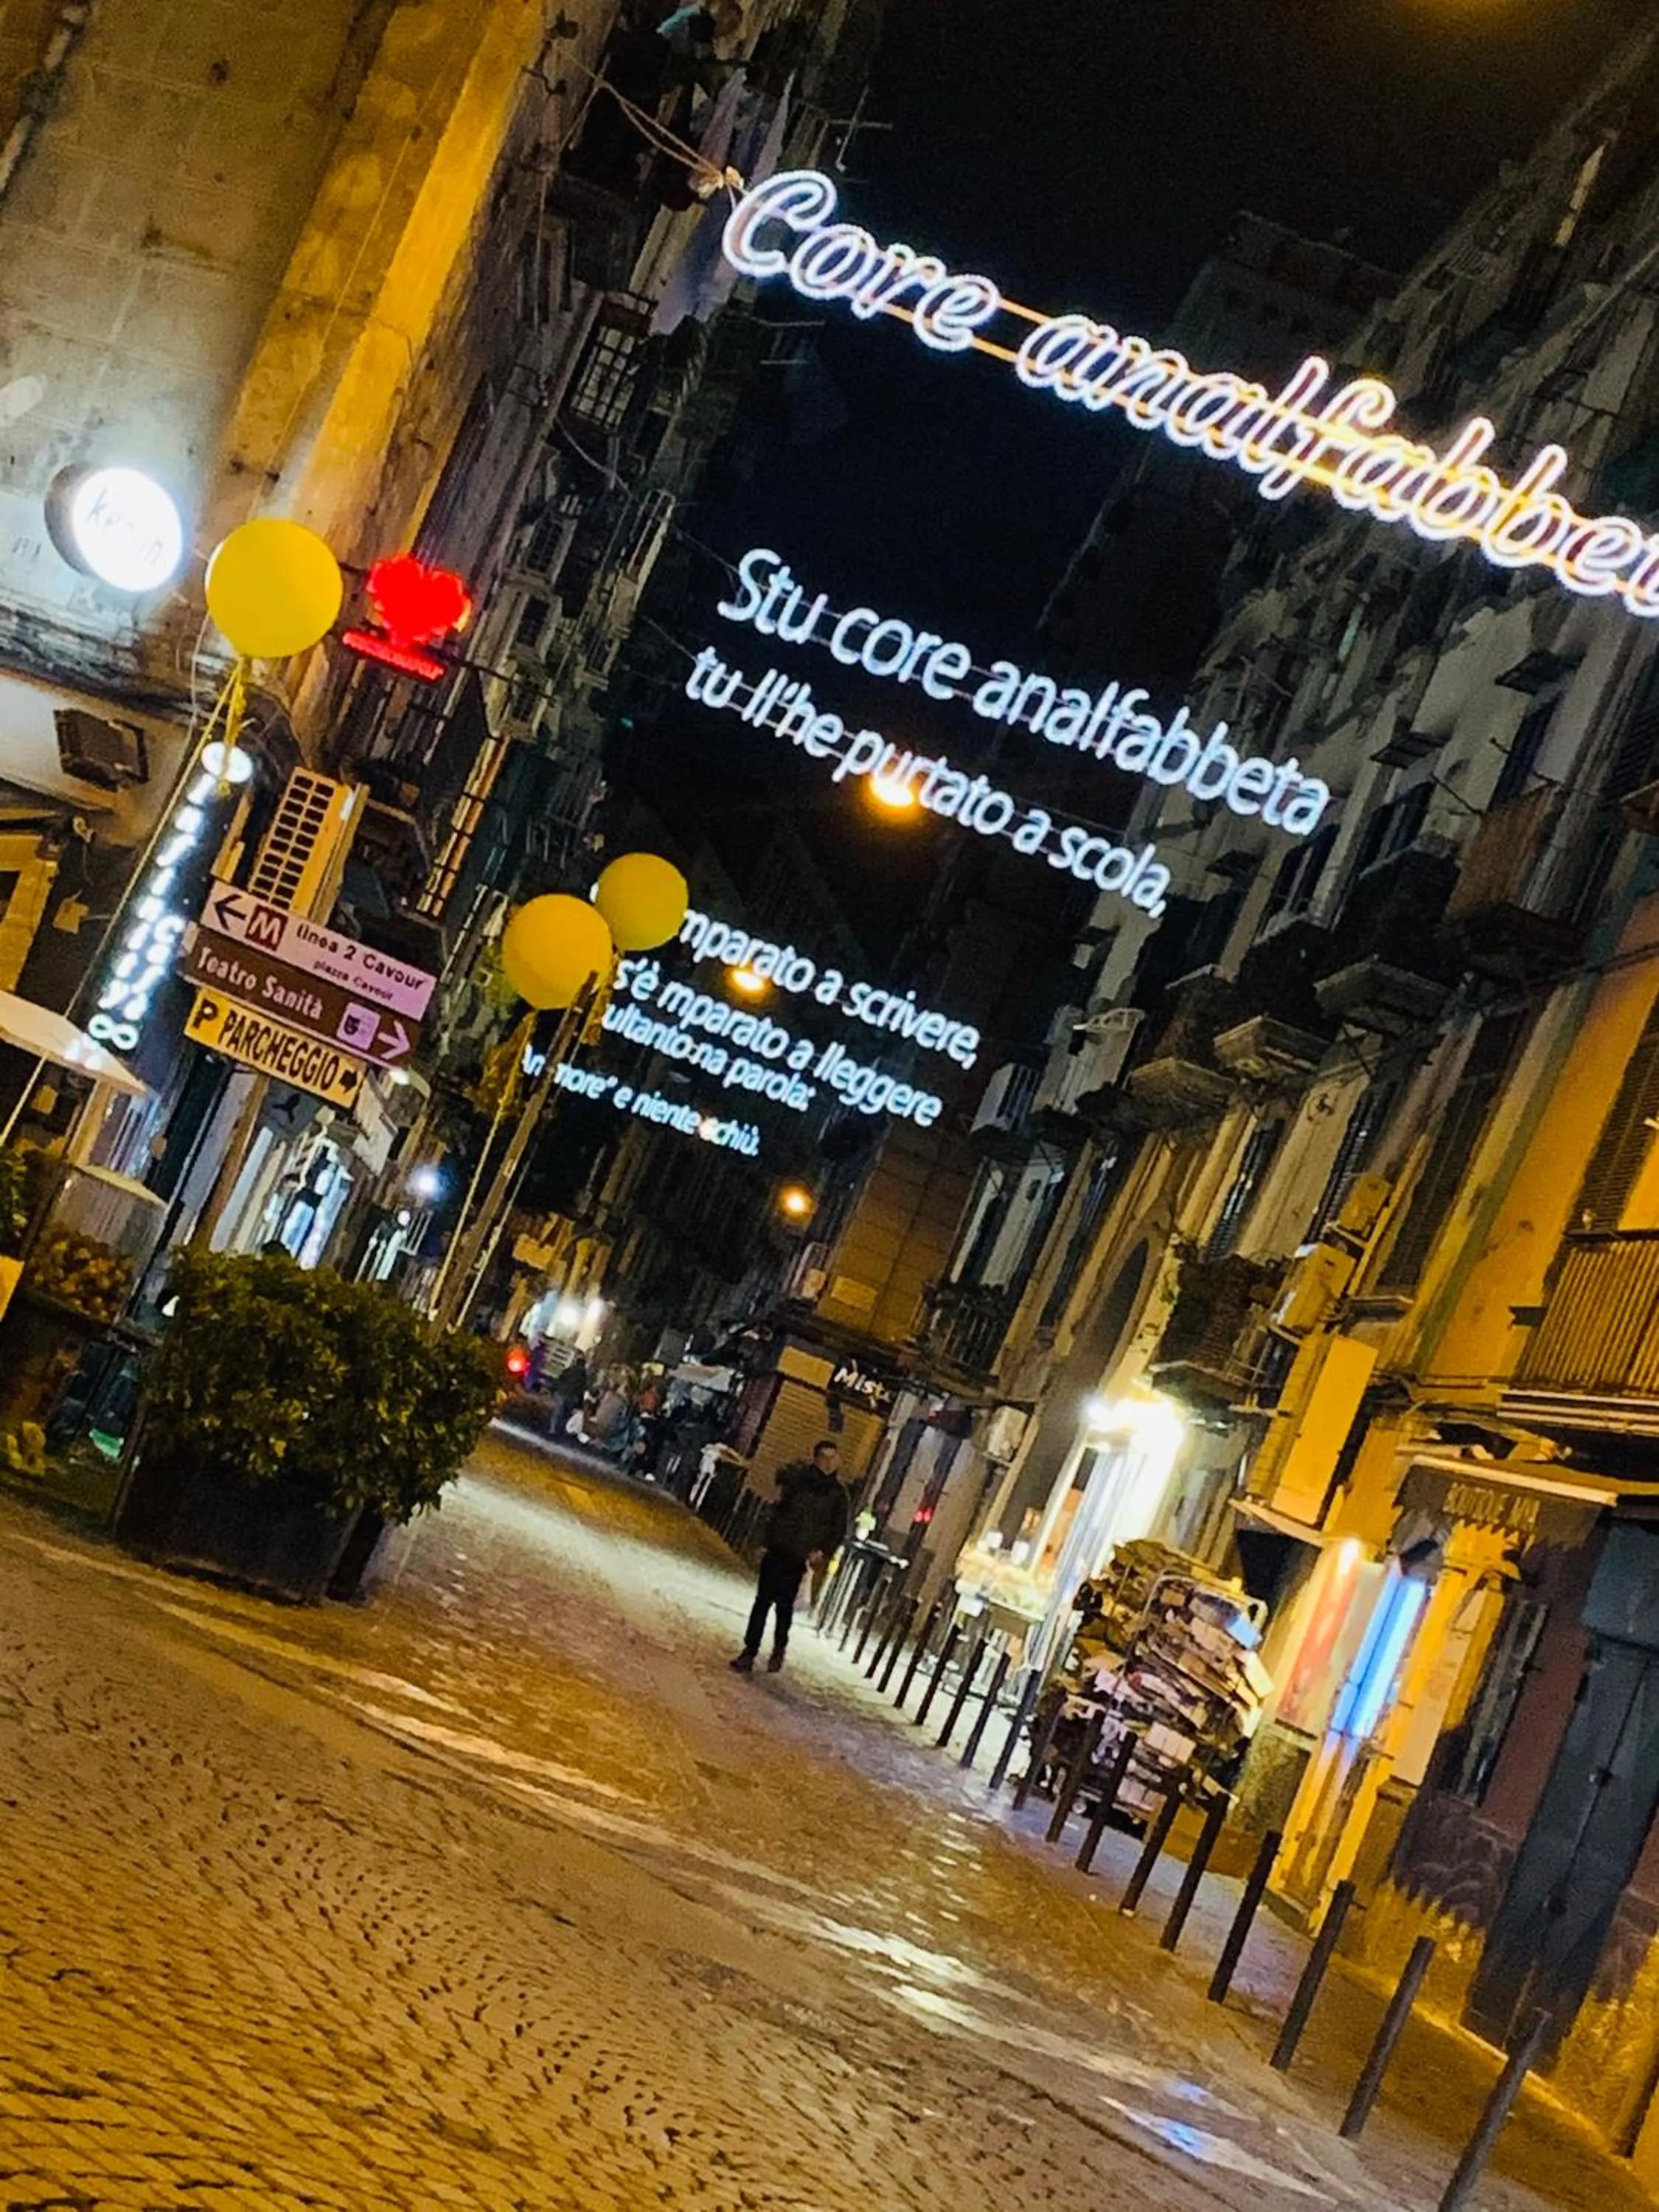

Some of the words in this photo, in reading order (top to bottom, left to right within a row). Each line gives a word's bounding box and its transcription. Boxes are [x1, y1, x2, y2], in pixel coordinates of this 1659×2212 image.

[720, 169, 1003, 352] Core
[717, 547, 829, 643] Stu
[830, 606, 970, 700] core
[973, 659, 1330, 836] analfabbeta
[684, 646, 743, 709] tu
[830, 730, 1015, 835] purtato
[1011, 807, 1051, 854] a
[1047, 825, 1172, 919] scola,
[197, 946, 258, 990] Teatro
[261, 975, 324, 1021] Sanità
[296, 923, 339, 954] linea
[344, 944, 357, 961] 2
[363, 953, 425, 992] Cavour
[192, 998, 219, 1030] P
[218, 1008, 341, 1092] PARCHEGGIO
[601, 1002, 693, 1060] ultanto
[722, 1057, 816, 1112] parola:
[659, 981, 790, 1060] mparato
[787, 1038, 815, 1071] a
[812, 1041, 943, 1127] lleggere
[814, 968, 844, 1006] a
[841, 981, 981, 1071] scrivere,
[613, 1086, 633, 1109] e
[630, 1091, 700, 1134] niente
